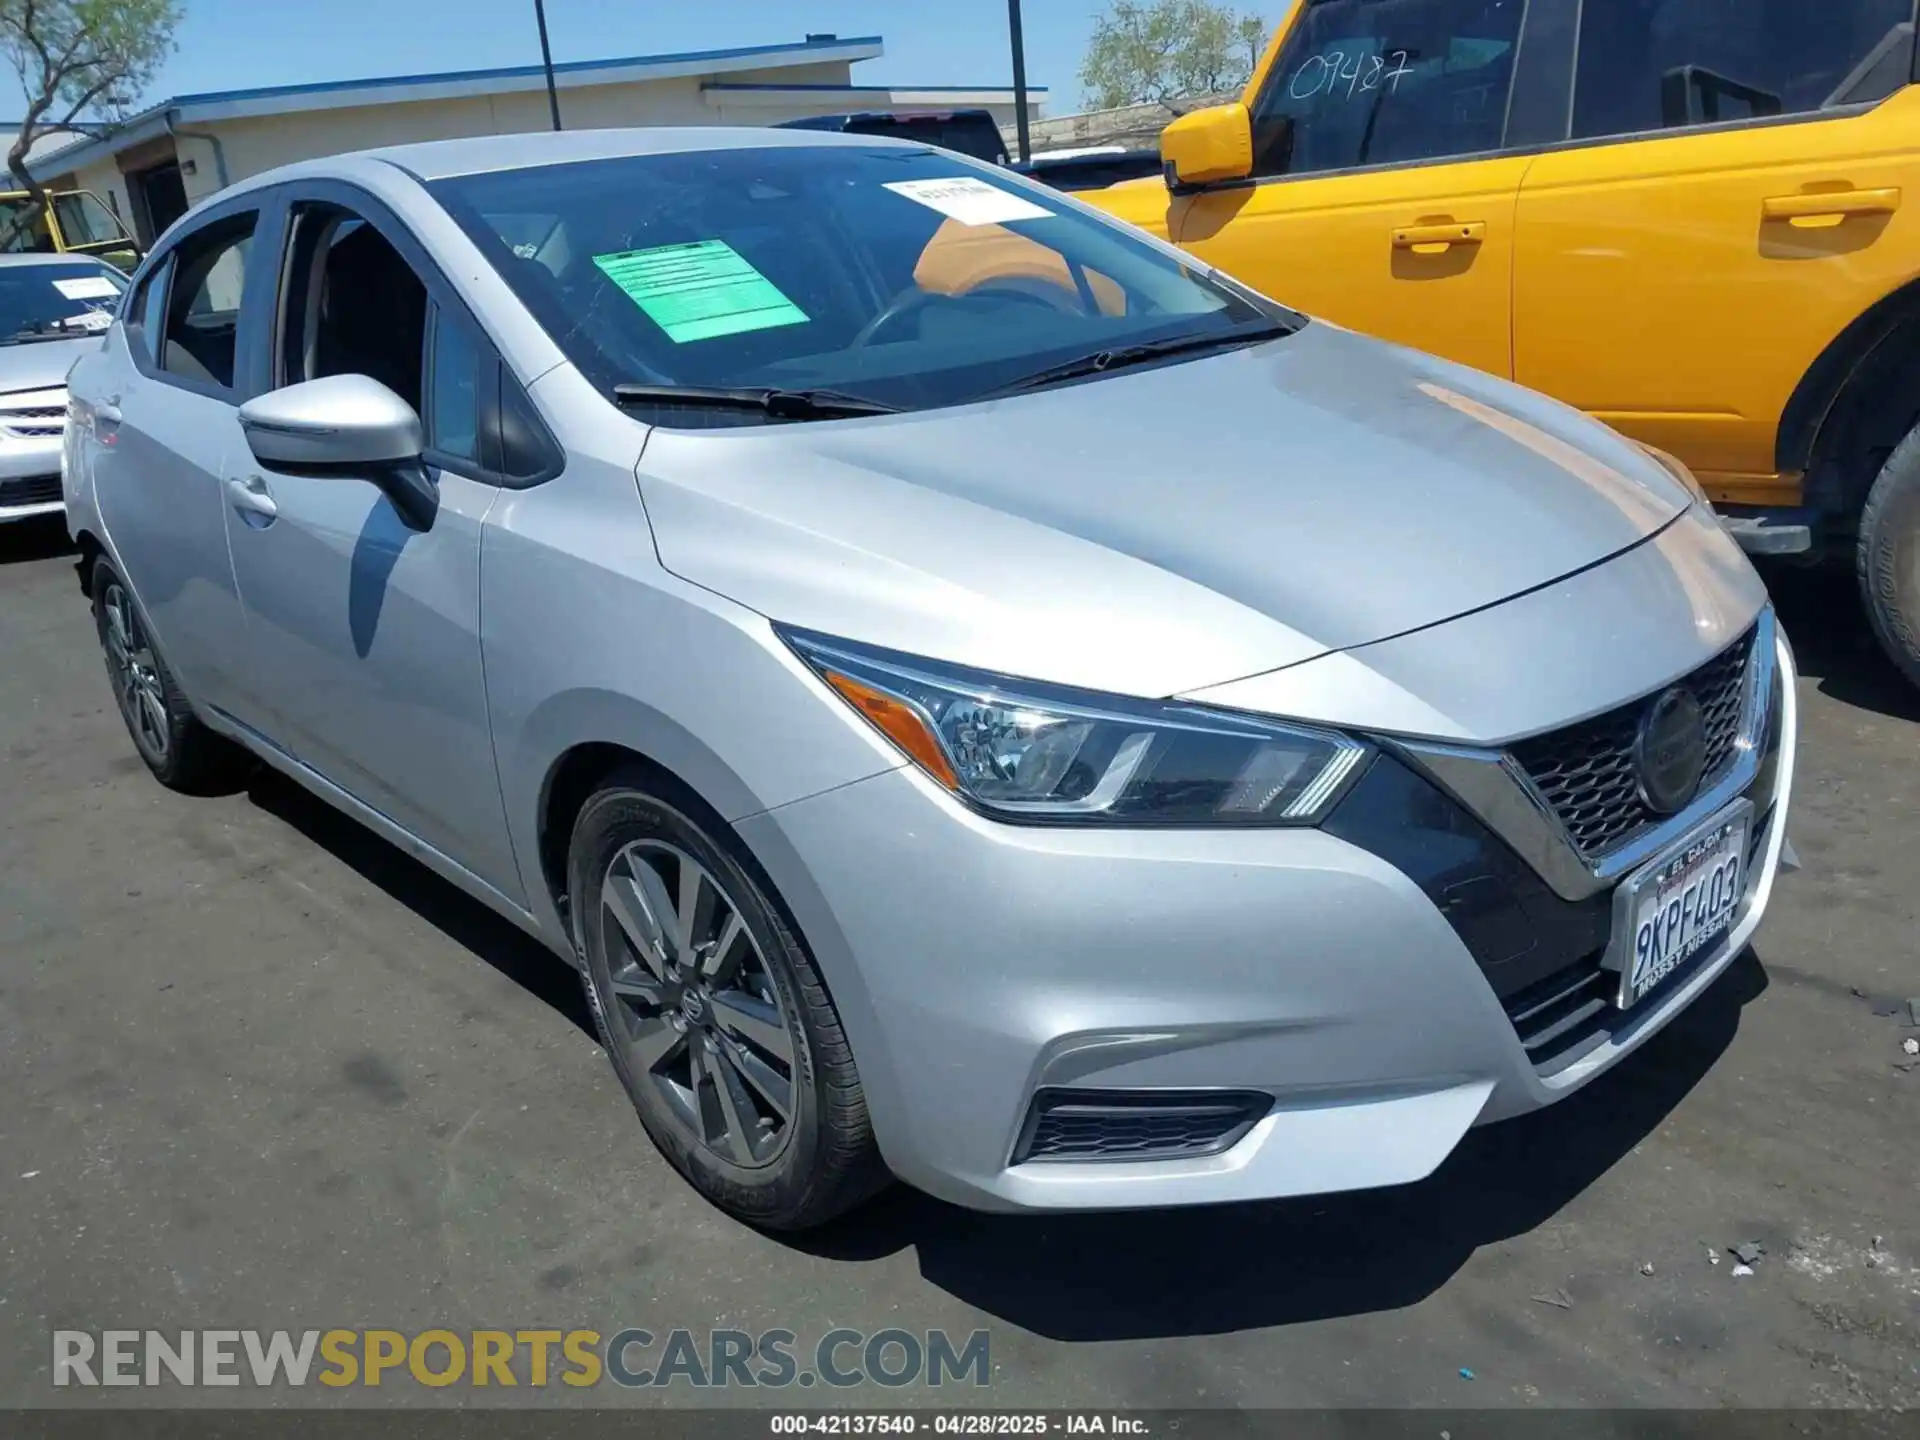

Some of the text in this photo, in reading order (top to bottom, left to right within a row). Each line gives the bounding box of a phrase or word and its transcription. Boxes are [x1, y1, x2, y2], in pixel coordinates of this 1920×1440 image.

[1290, 51, 1415, 101] 09487
[1633, 855, 1738, 983] 9KPF403
[1638, 912, 1733, 996] MOSSY NISSAN
